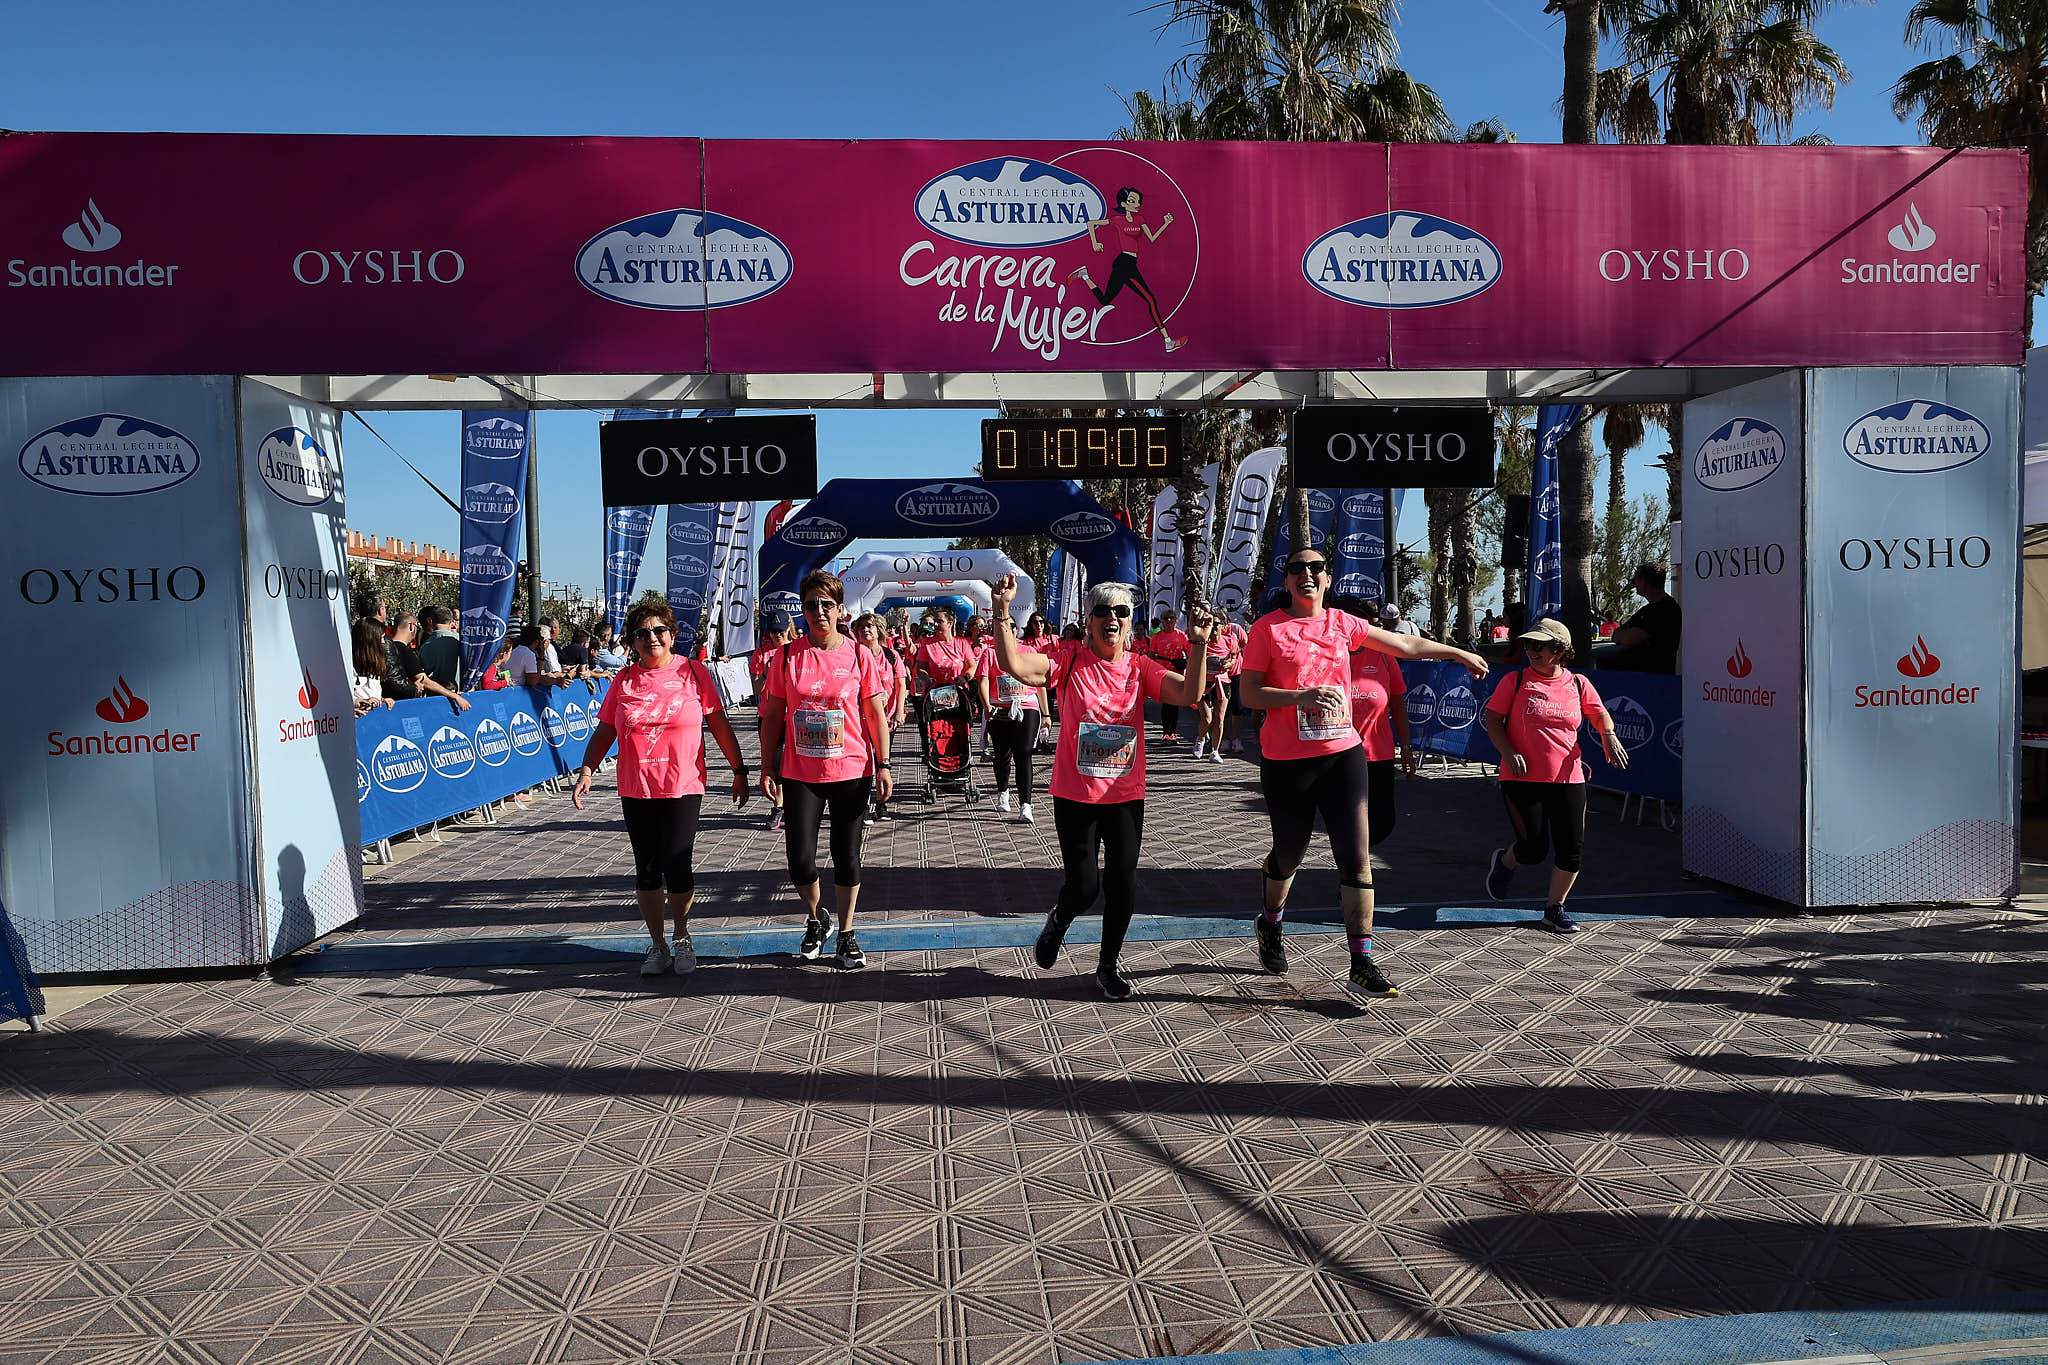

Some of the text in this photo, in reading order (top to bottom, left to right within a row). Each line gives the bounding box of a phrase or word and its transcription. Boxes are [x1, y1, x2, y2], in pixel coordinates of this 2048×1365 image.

[930, 188, 1090, 224] ASTURIANA
[959, 187, 1085, 198] CENTRAL LECHERA
[625, 244, 694, 254] CENTRAL
[899, 240, 1057, 289] Carrera
[1317, 246, 1488, 282] ASTURIANA
[1348, 244, 1480, 254] CENTRAL LECHERA
[8, 260, 178, 288] Santander
[292, 249, 466, 285] OYSHO
[592, 246, 778, 284] ASTURIANA
[1599, 248, 1750, 283] OYSHO
[1841, 258, 1981, 284] Santander
[939, 290, 996, 323] de la
[991, 284, 1116, 362] Mujer
[1853, 427, 1981, 456] ASTURIANA
[1875, 423, 1975, 434] CENTRAL LECHERA
[33, 444, 188, 477] ASTURIANA
[60, 441, 180, 451] CENTRAL LECHERA
[636, 444, 788, 477] OYSHO
[996, 427, 1168, 469] 01:09:06
[1326, 432, 1467, 462] OYSHO
[264, 447, 332, 491] ASTURIANA
[1699, 445, 1780, 479] ASTURIANA
[903, 496, 992, 517] ASTURIANA
[893, 556, 974, 574] OYSHO
[1695, 543, 1785, 580] OYSHO
[1839, 536, 1991, 572] OYSHO
[20, 565, 206, 605] OYSHO
[264, 563, 340, 602] OYSHO
[1702, 681, 1777, 708] Santander
[1854, 682, 1980, 708] Santander
[47, 727, 201, 757] Santander
[279, 712, 340, 743] Santander
[433, 747, 474, 768] ASTURIANA
[479, 738, 509, 757] ASTURIANA
[378, 758, 426, 783] ASTURIANA
